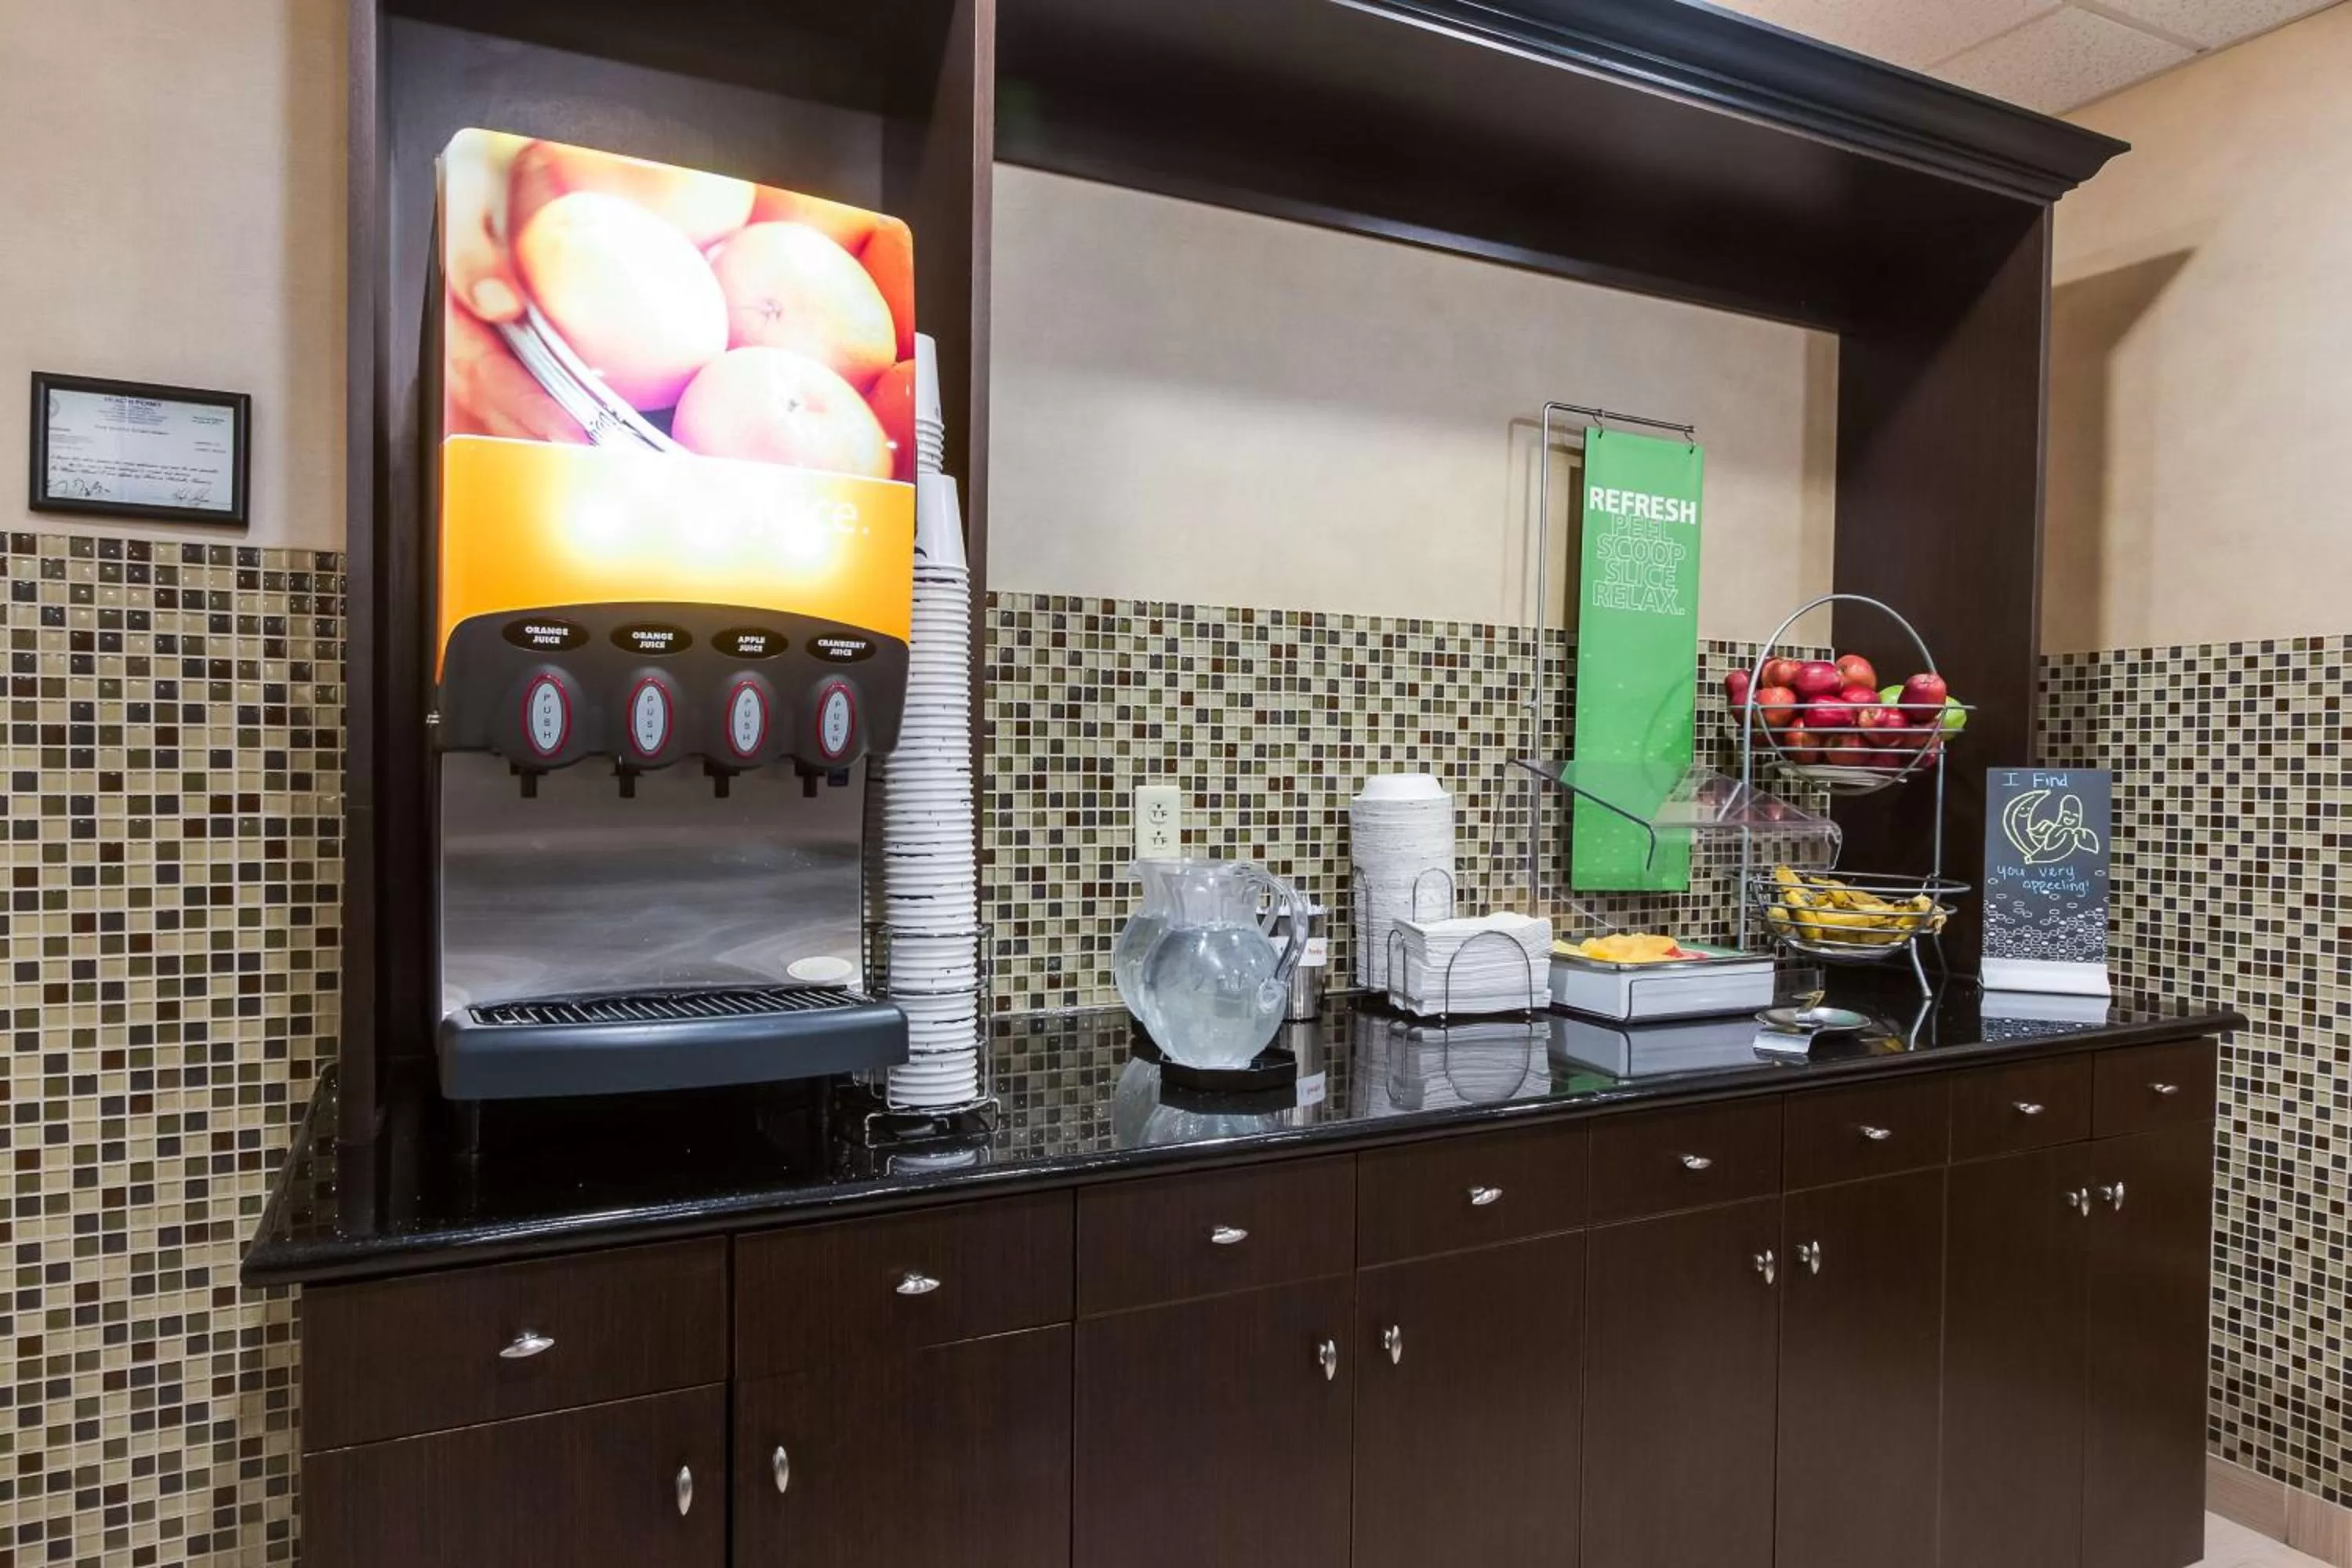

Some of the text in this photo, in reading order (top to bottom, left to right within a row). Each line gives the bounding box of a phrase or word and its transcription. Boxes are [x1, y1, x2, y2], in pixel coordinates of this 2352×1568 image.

[1588, 486, 1697, 524] REFRESH
[1612, 514, 1673, 544] PEEL
[1596, 533, 1686, 567] SCOOP
[1605, 558, 1676, 590] SLICE
[1592, 580, 1685, 615] RELAX.
[524, 626, 569, 636] ORANGE
[631, 631, 674, 641] ORANGE
[532, 635, 561, 644] JUICE
[639, 641, 666, 649] JUICE
[737, 636, 766, 644] APPLE
[818, 639, 866, 649] CRANBERRY
[738, 644, 763, 652] JUICE
[645, 695, 655, 741] PUSH
[832, 700, 841, 742] PUSH
[2002, 772, 2069, 788] I Find
[1996, 865, 2076, 882] you very
